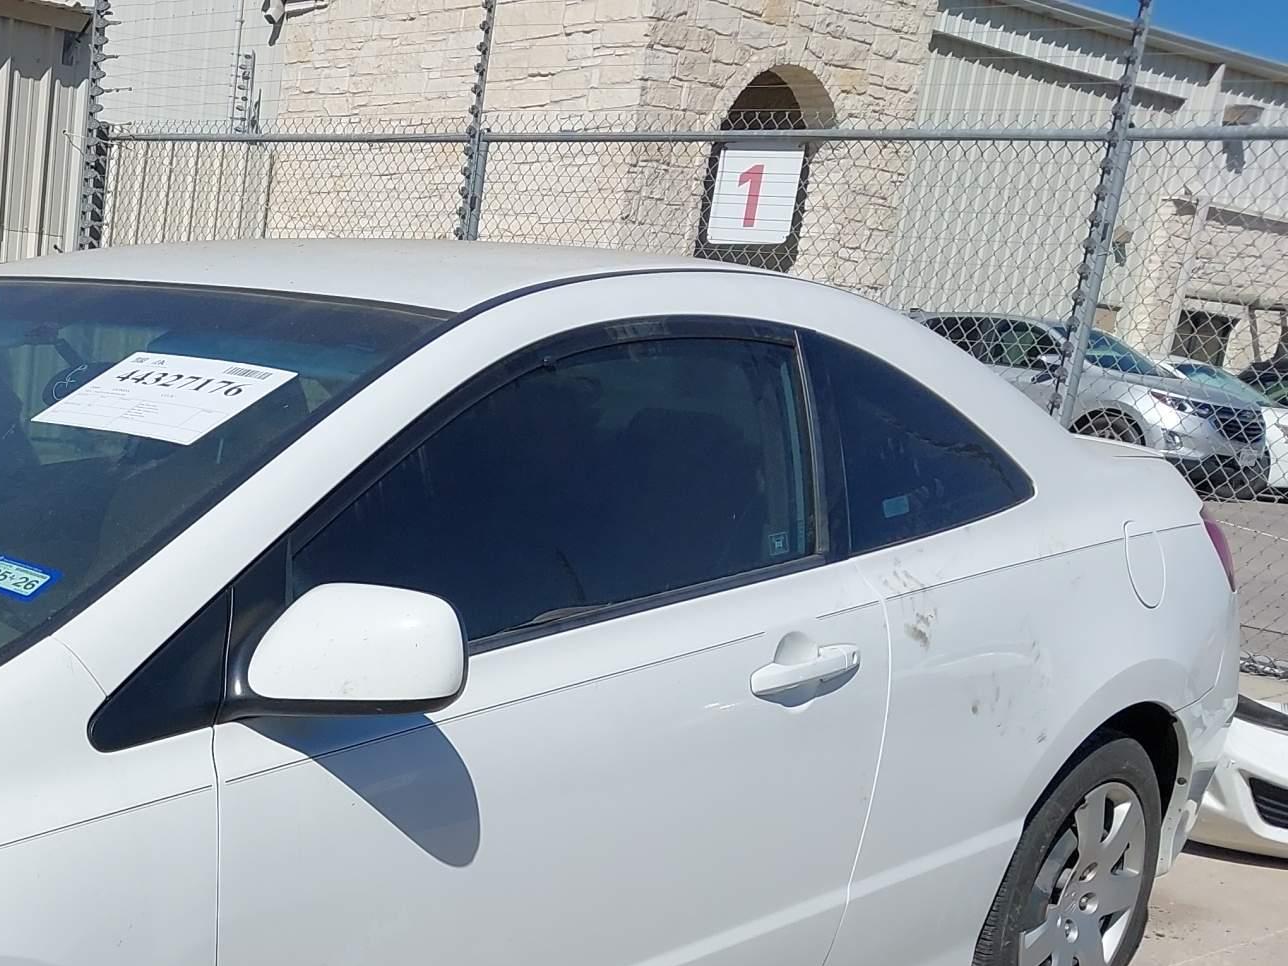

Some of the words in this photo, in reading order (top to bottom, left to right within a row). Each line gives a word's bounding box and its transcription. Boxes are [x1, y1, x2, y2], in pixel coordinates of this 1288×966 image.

[738, 164, 765, 228] 1
[115, 369, 253, 397] 44327176
[12, 576, 40, 591] 26
